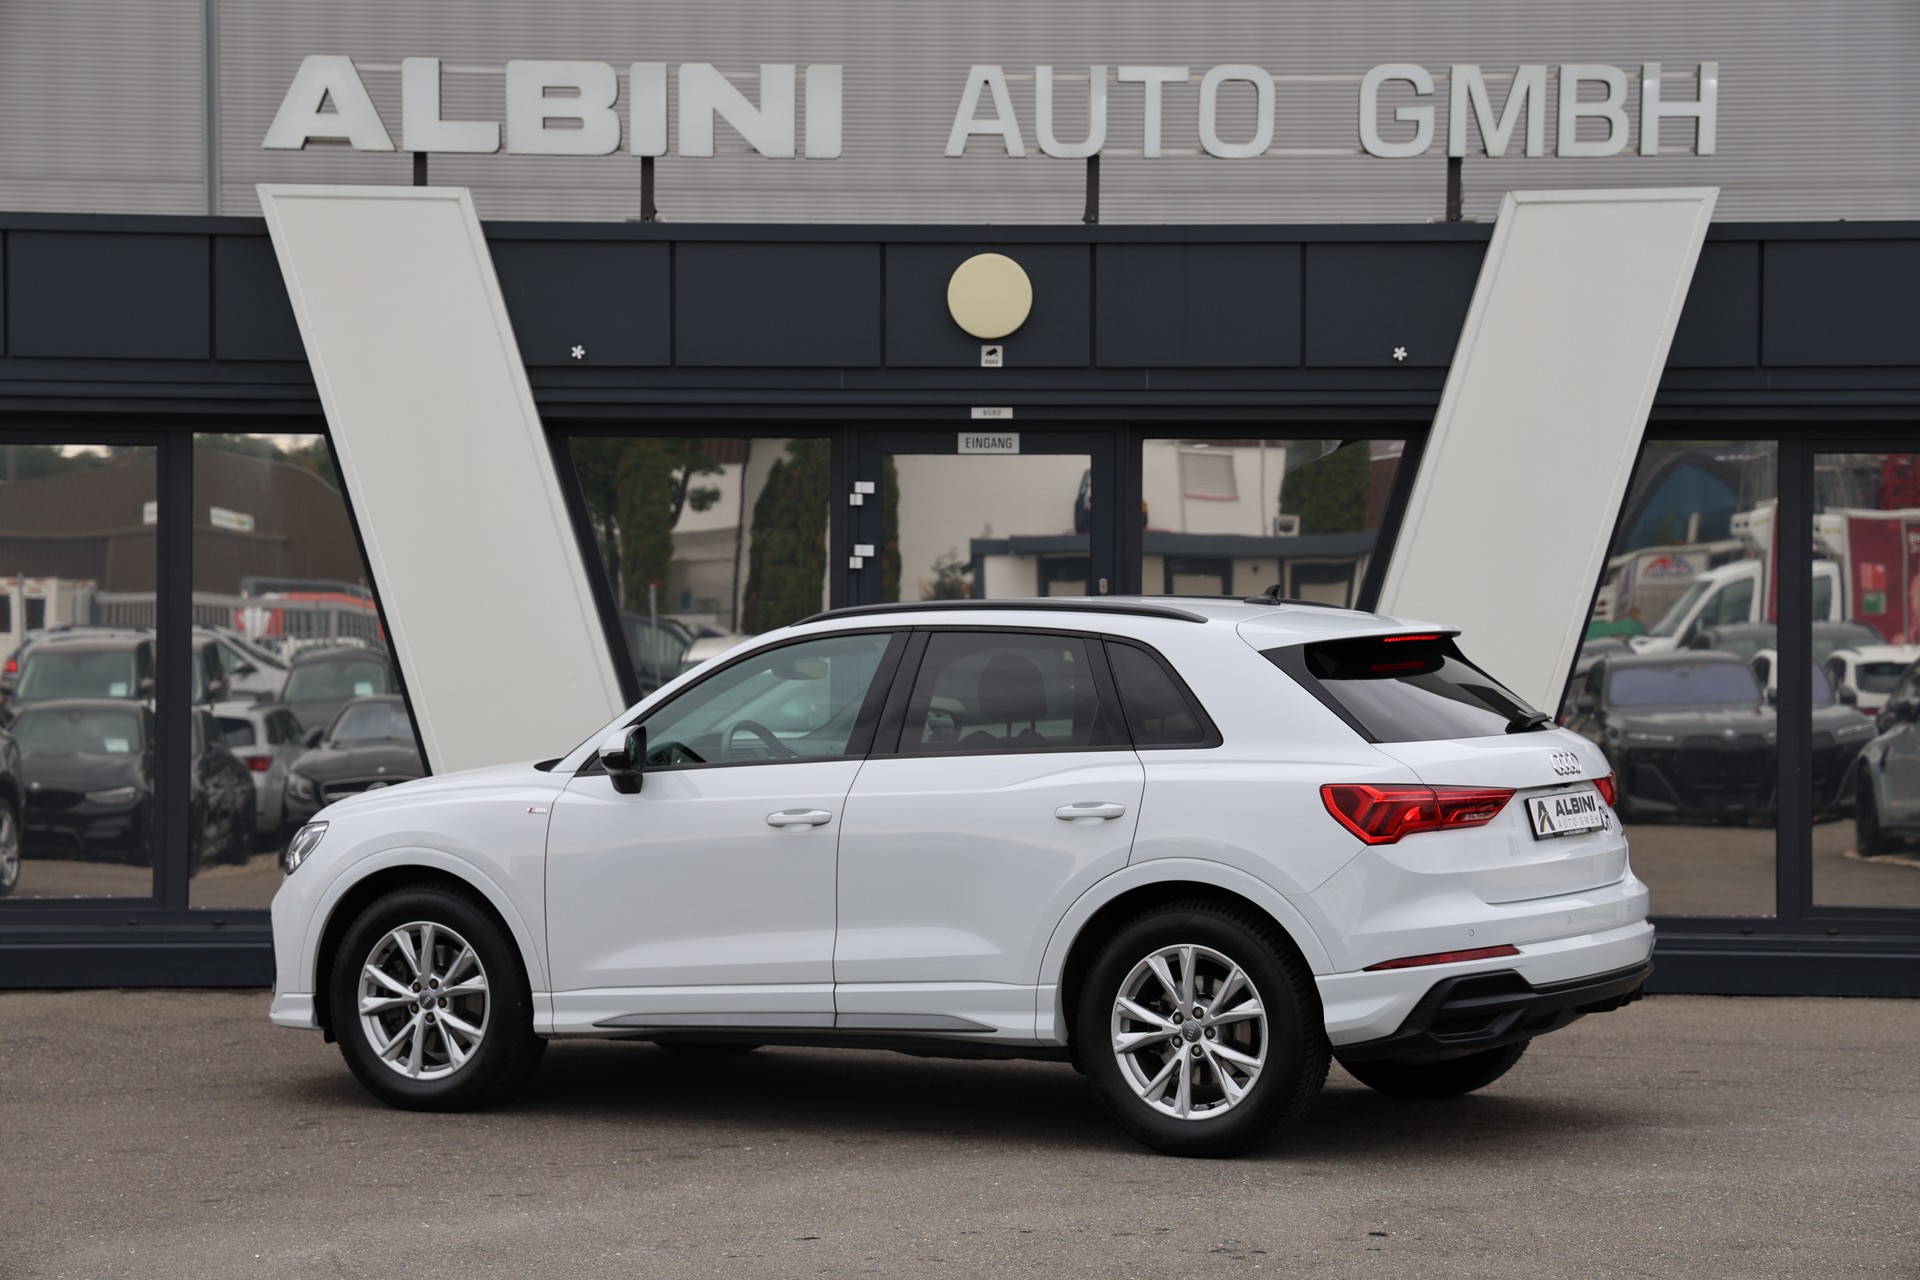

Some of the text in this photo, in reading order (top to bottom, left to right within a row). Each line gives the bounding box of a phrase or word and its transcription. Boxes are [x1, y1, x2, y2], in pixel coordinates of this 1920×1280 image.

[261, 54, 1719, 160] ALBINI AUTO GMBH
[965, 437, 1013, 449] EINGANG
[1556, 795, 1597, 817] ALBINI
[1558, 814, 1600, 828] AUTO GMBH
